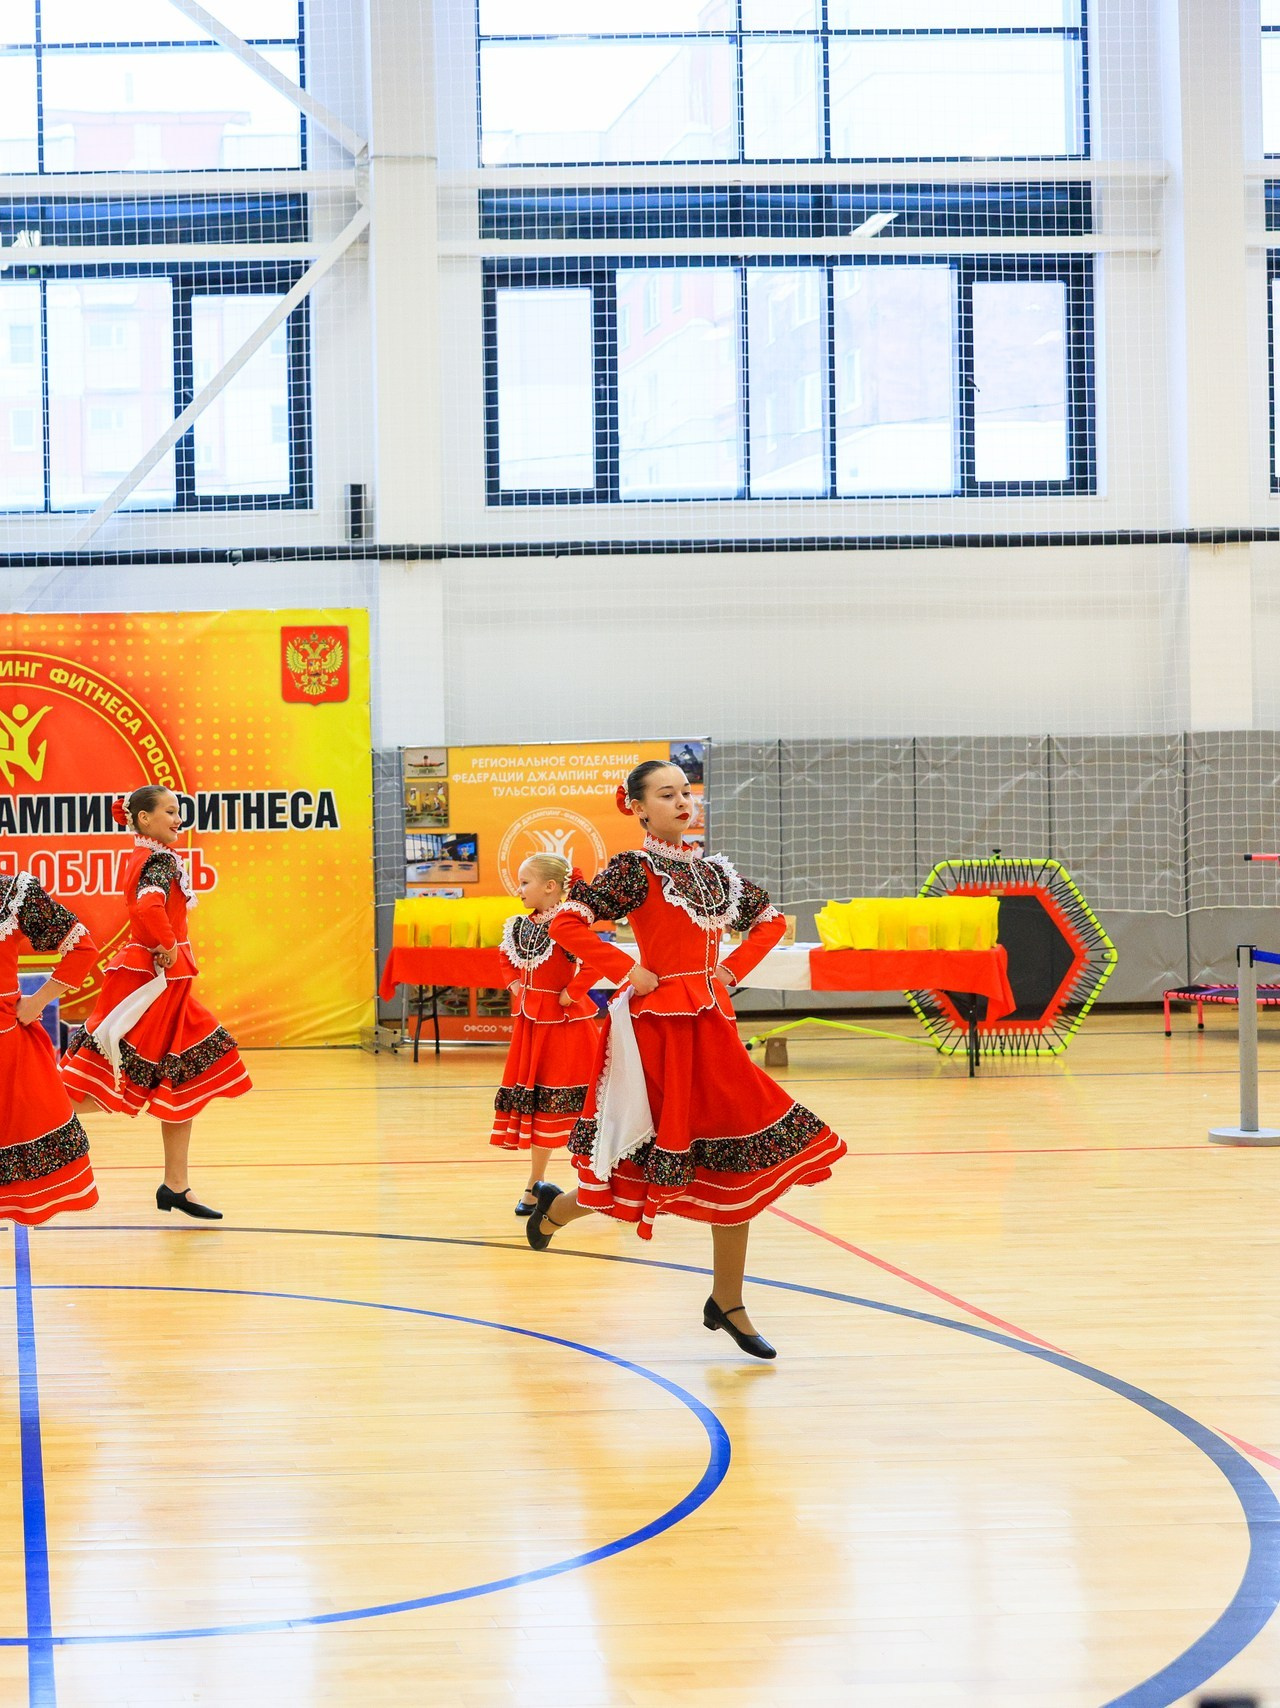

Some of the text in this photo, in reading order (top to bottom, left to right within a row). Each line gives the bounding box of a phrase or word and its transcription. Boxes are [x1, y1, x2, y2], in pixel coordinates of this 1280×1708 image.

[49, 668, 142, 736] ФИТНЕСА
[138, 734, 176, 789] РОСС
[471, 754, 639, 769] РЕГИОНАЛЬНОЕ ОТДЕЛЕНИЕ
[452, 769, 630, 784] ФЕДЕРАЦИИ ДЖАМПИНГ ФИТН
[492, 783, 619, 797] ТУЛЬСКОЙ ОБЛАСТИ
[28, 847, 218, 896] ОБЛЬ
